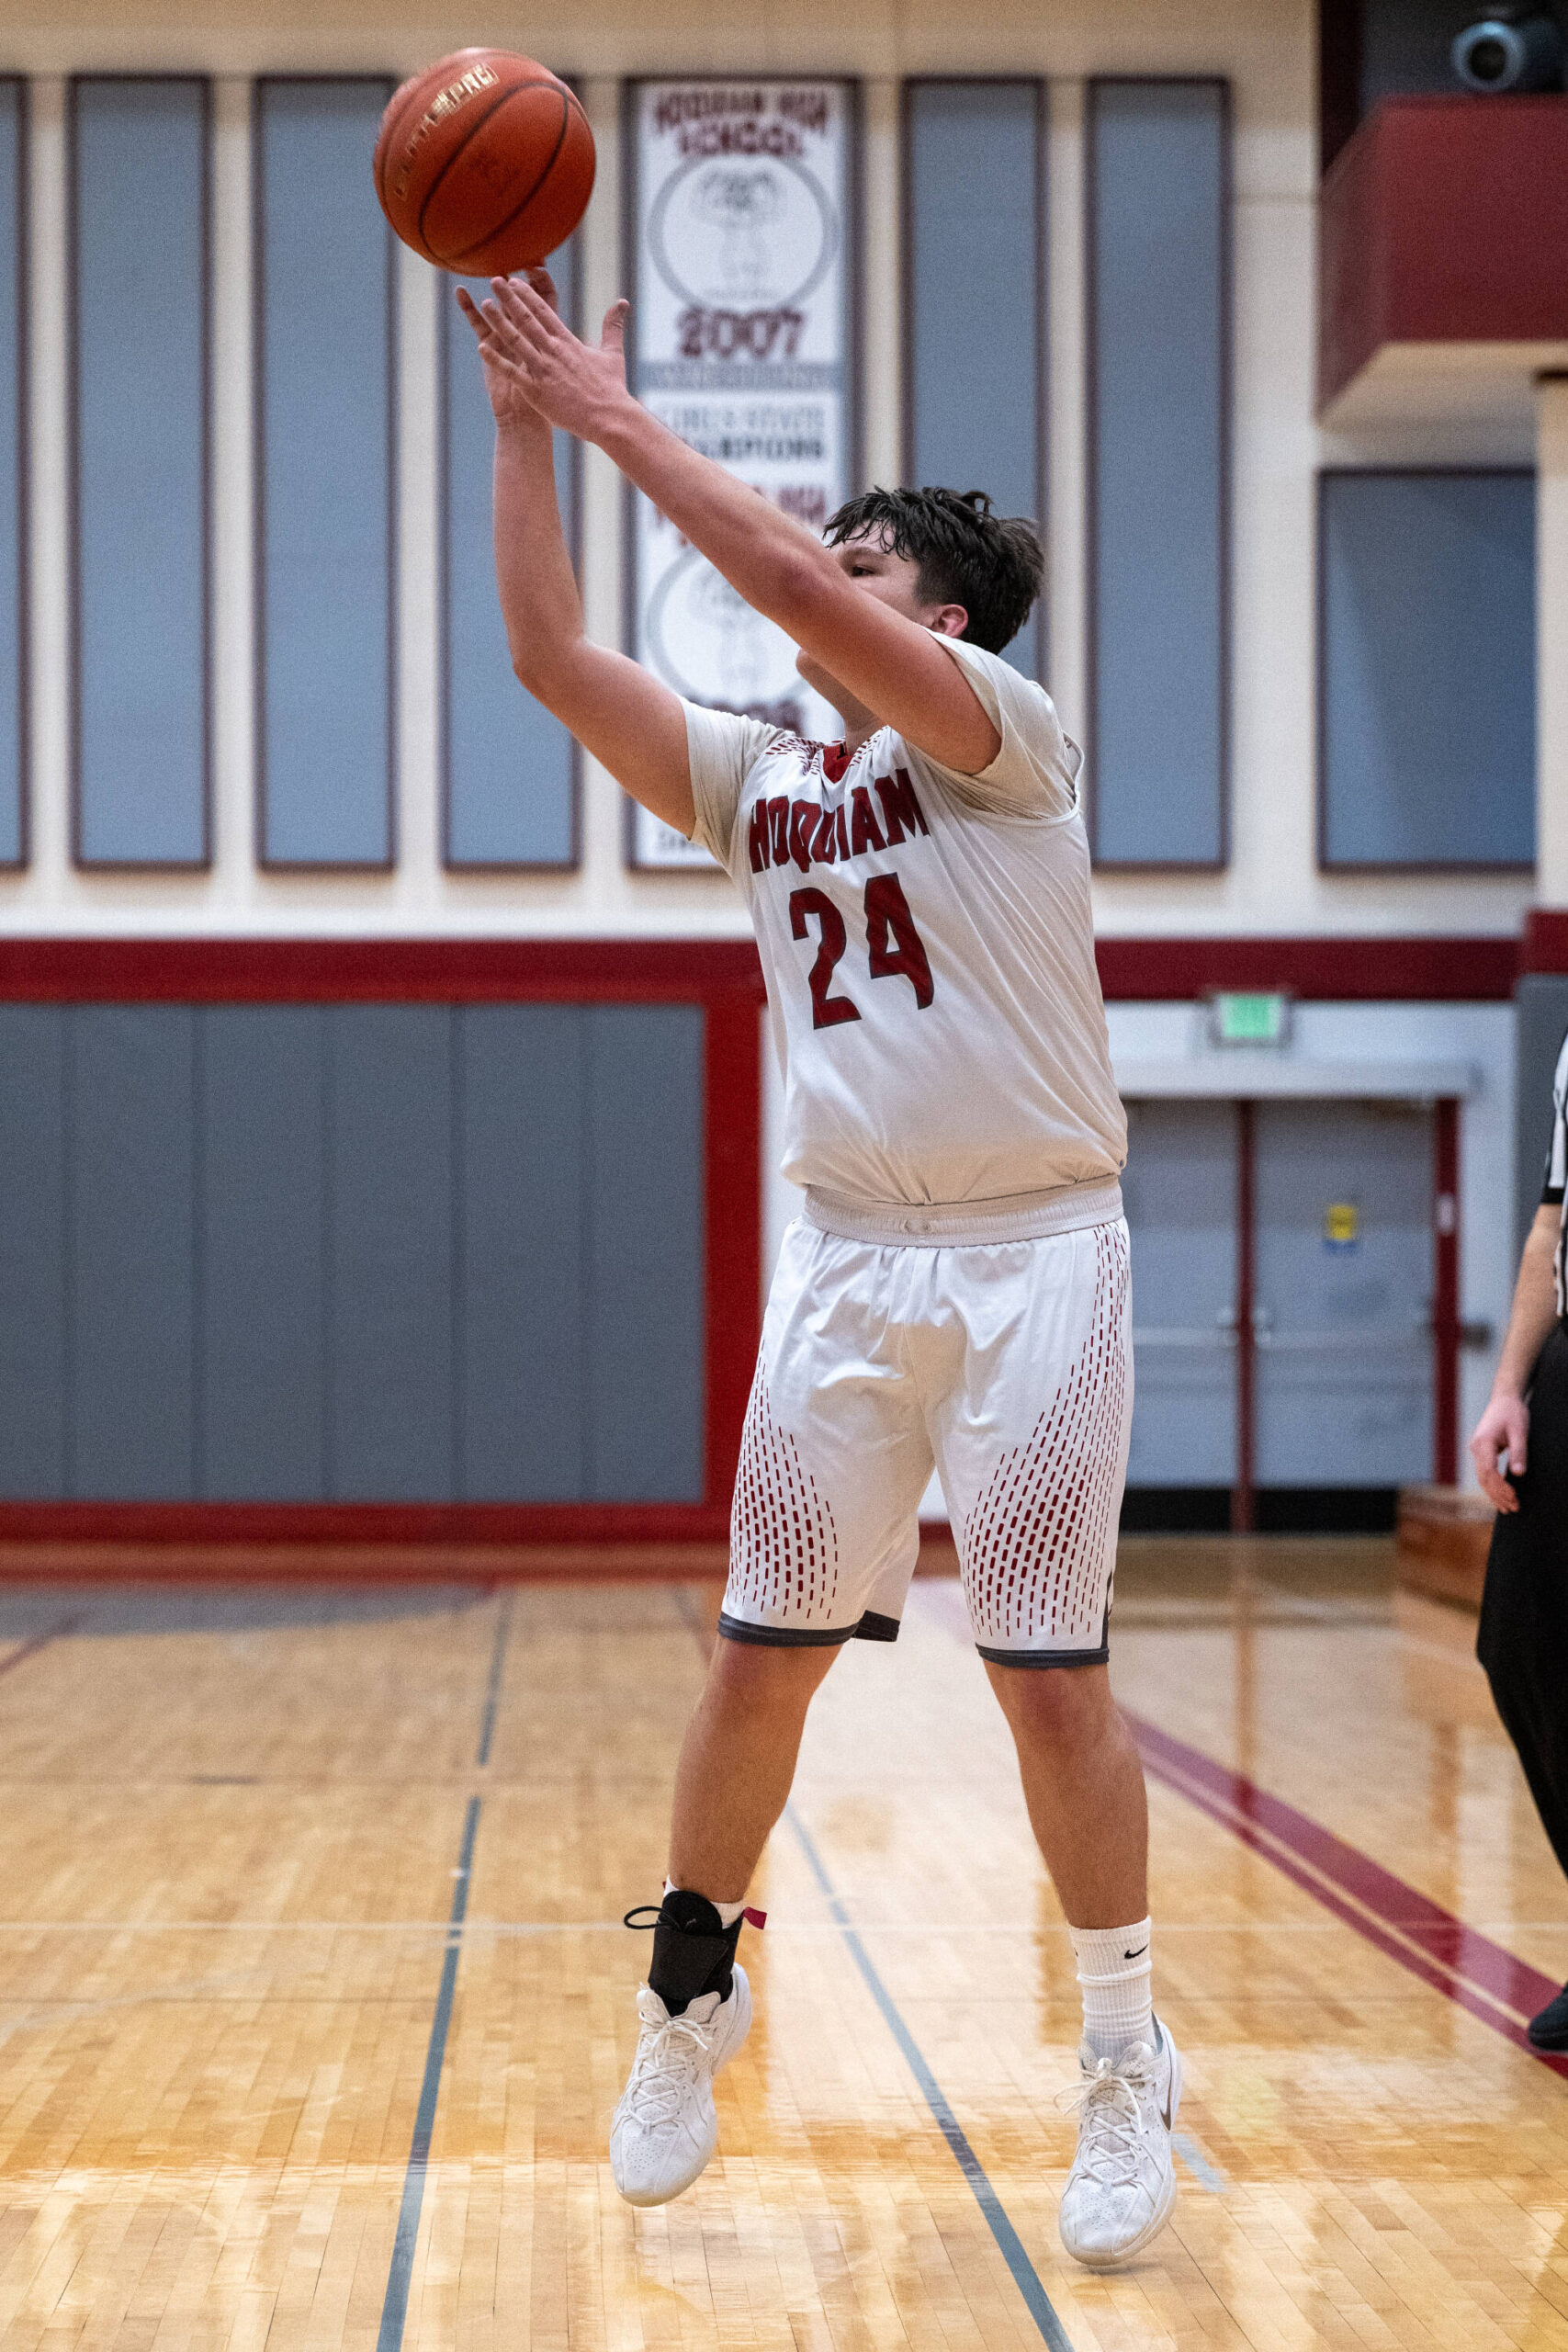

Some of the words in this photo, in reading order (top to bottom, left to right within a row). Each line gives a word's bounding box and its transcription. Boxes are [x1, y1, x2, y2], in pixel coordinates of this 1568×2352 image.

[676, 308, 806, 357] 2007
[749, 768, 931, 873] HOQUIAM
[789, 872, 934, 1030] 24
